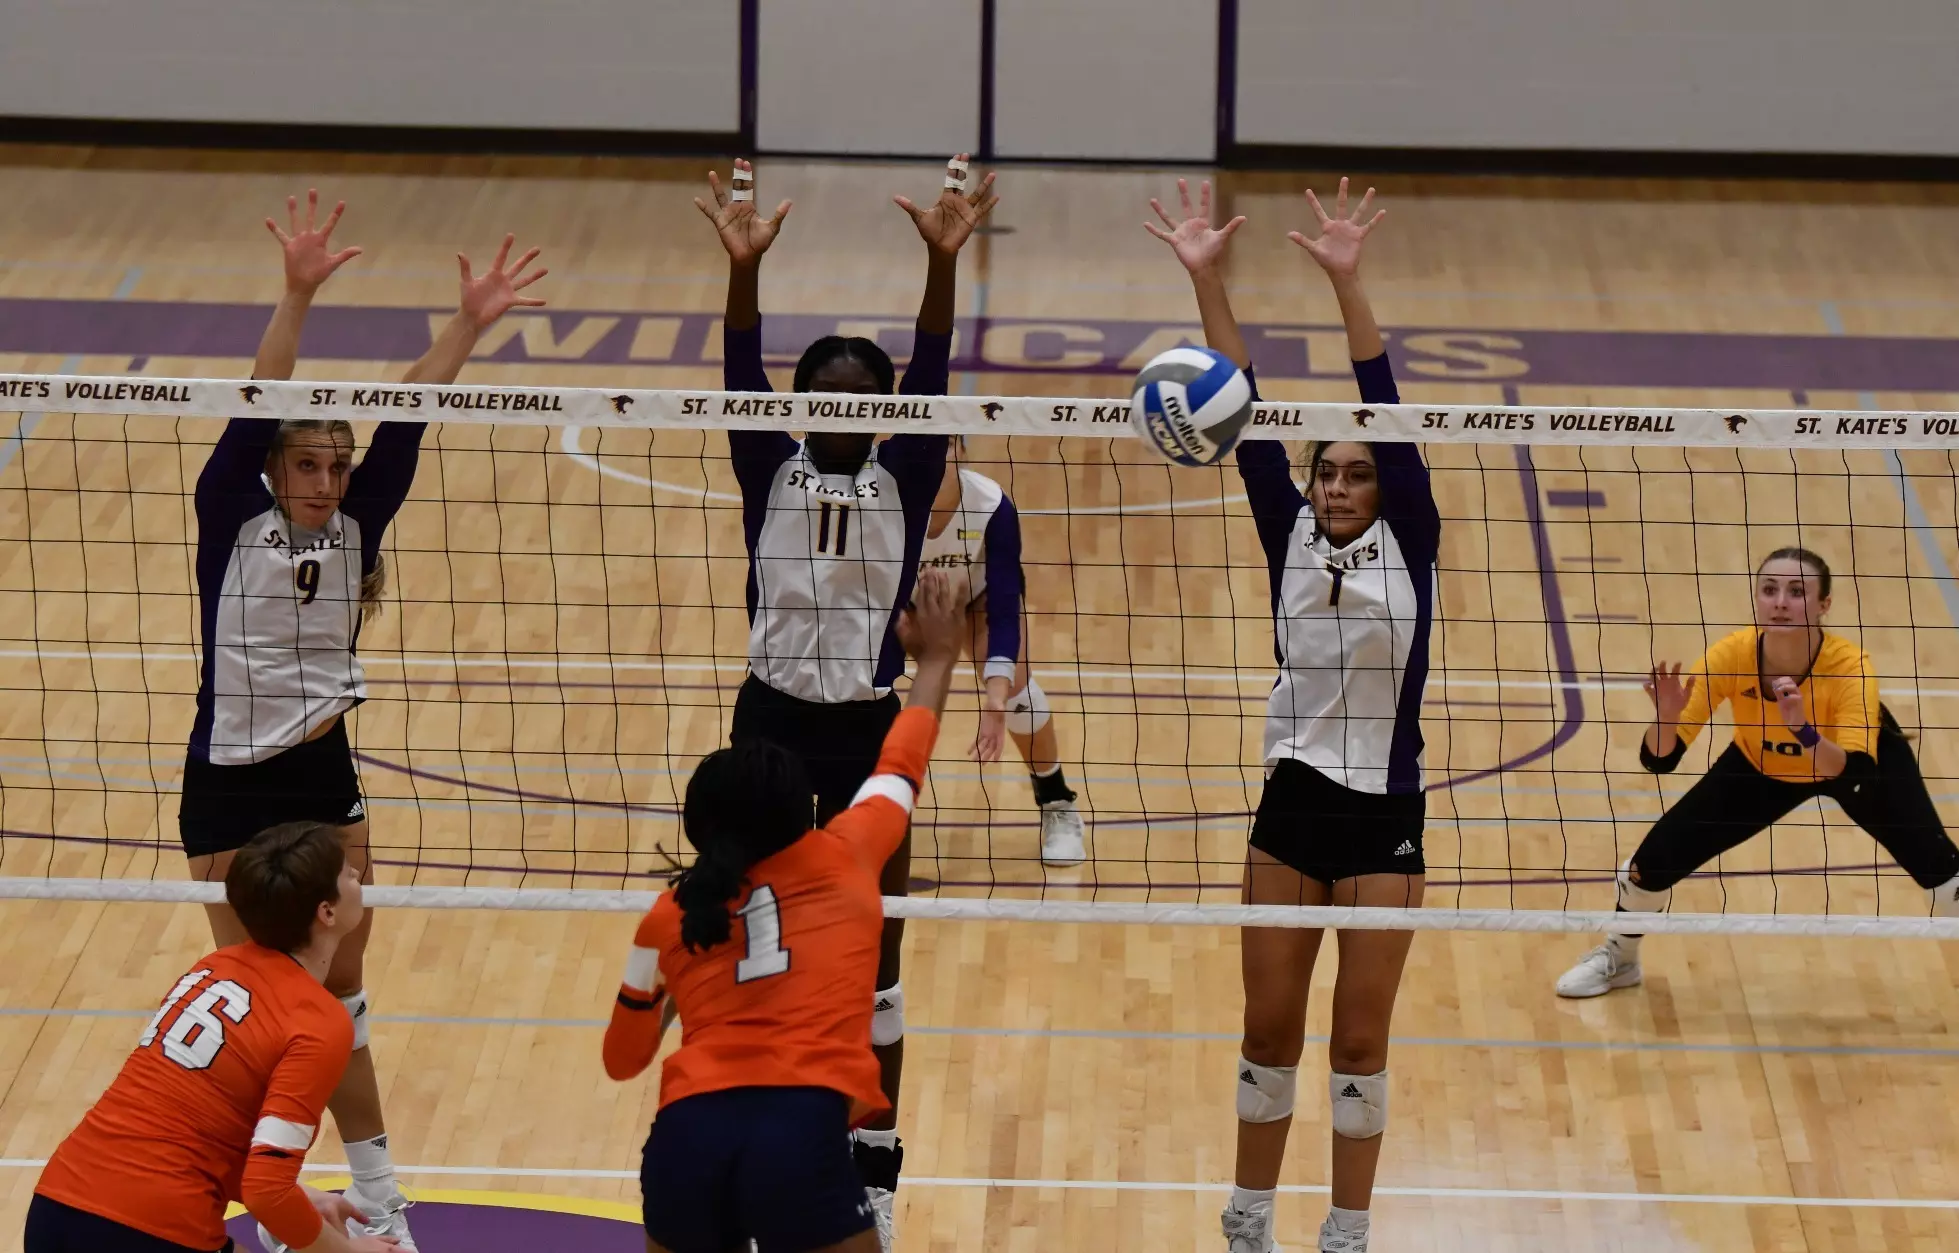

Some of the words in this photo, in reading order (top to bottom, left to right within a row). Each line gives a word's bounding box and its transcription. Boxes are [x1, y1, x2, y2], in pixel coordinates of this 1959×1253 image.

[0, 380, 51, 398] ATE'S
[65, 382, 192, 402] VOLLEYBALL
[309, 388, 337, 406] ST.
[351, 389, 423, 408] KATE'S
[437, 391, 563, 412] VOLLEYBALL
[681, 398, 708, 415] ST.
[722, 398, 793, 417] KATE'S
[807, 400, 933, 420] VOLLEYBALL
[1050, 405, 1078, 422] ST.
[1091, 406, 1132, 423] KAT
[1165, 396, 1206, 455] molten
[1421, 412, 1449, 429] ST.
[1463, 412, 1535, 431] KATE'S
[1550, 413, 1676, 433] VOLLEYBALL
[1794, 417, 1822, 435] ST.
[1835, 417, 1908, 435] KATE'S
[816, 500, 850, 555] 11
[296, 559, 321, 604] 9
[735, 883, 792, 985] 1
[138, 967, 252, 1071] 16
